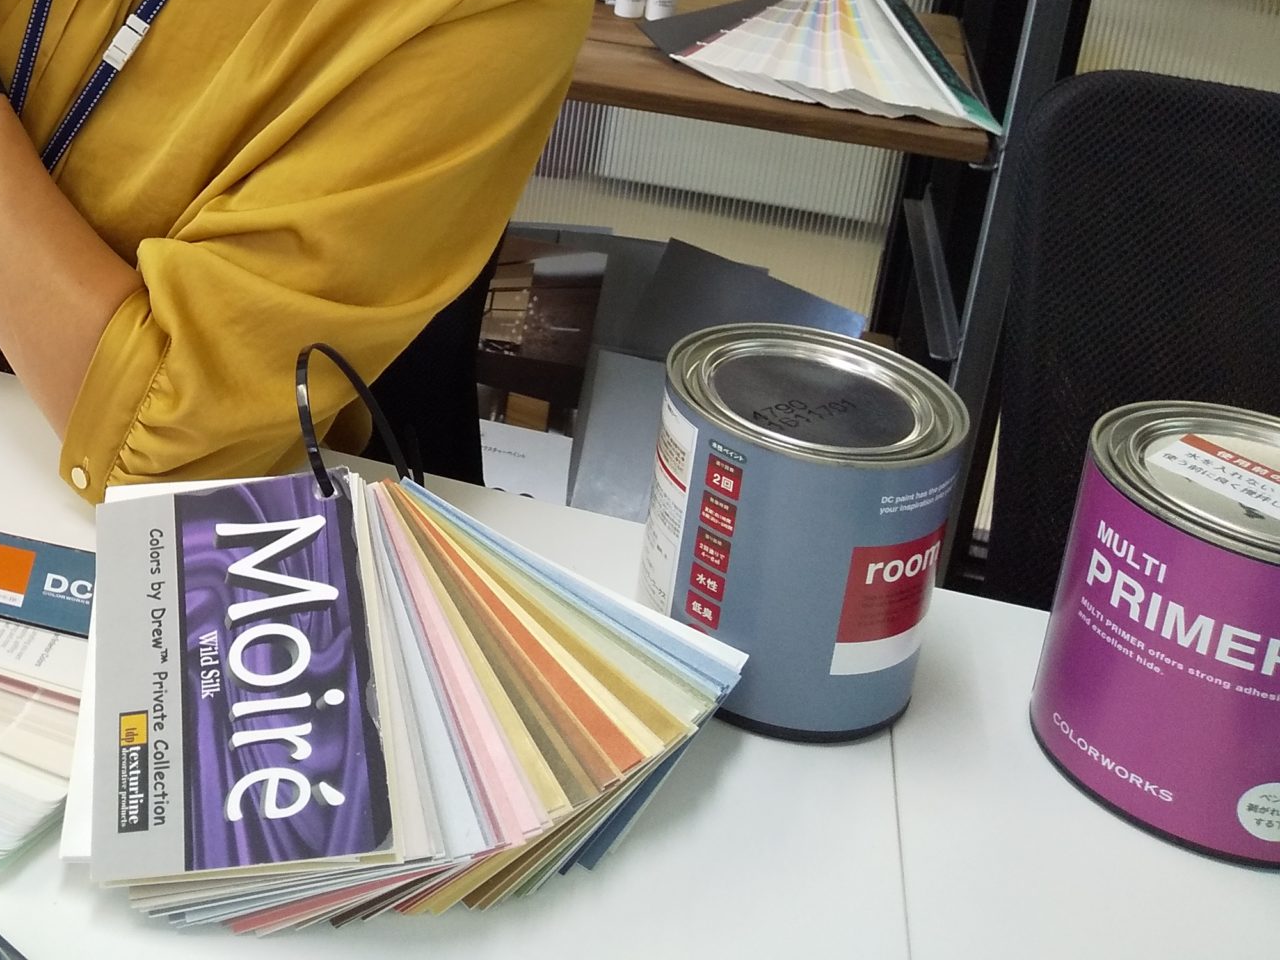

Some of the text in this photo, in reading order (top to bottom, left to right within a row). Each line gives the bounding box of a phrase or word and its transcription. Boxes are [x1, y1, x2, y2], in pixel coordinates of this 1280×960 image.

[712, 473, 734, 492] 2回
[881, 495, 894, 504] DC
[895, 493, 914, 504] paint
[1186, 452, 1275, 493] 水を入れない
[880, 505, 899, 515] your
[899, 497, 934, 512] inspiration
[149, 528, 165, 575] Colors
[865, 540, 941, 585] room
[1097, 519, 1167, 583] MULTI
[43, 572, 93, 599] DC
[146, 581, 166, 600] by
[696, 573, 718, 593] 水性
[691, 600, 713, 621] 低臭
[198, 630, 221, 699] Wild Silk
[215, 515, 346, 821] Moiré
[1078, 610, 1166, 676] and excellent hide.
[1080, 596, 1104, 622] MULTI
[1105, 618, 1146, 651] PRIMER
[1148, 647, 1184, 671] offers
[1187, 666, 1231, 691] strong
[152, 671, 168, 732] Private
[153, 739, 170, 826] Collection
[1052, 711, 1174, 802] COLORWORKS
[118, 747, 130, 828] decorative products
[128, 746, 145, 825] texturline
